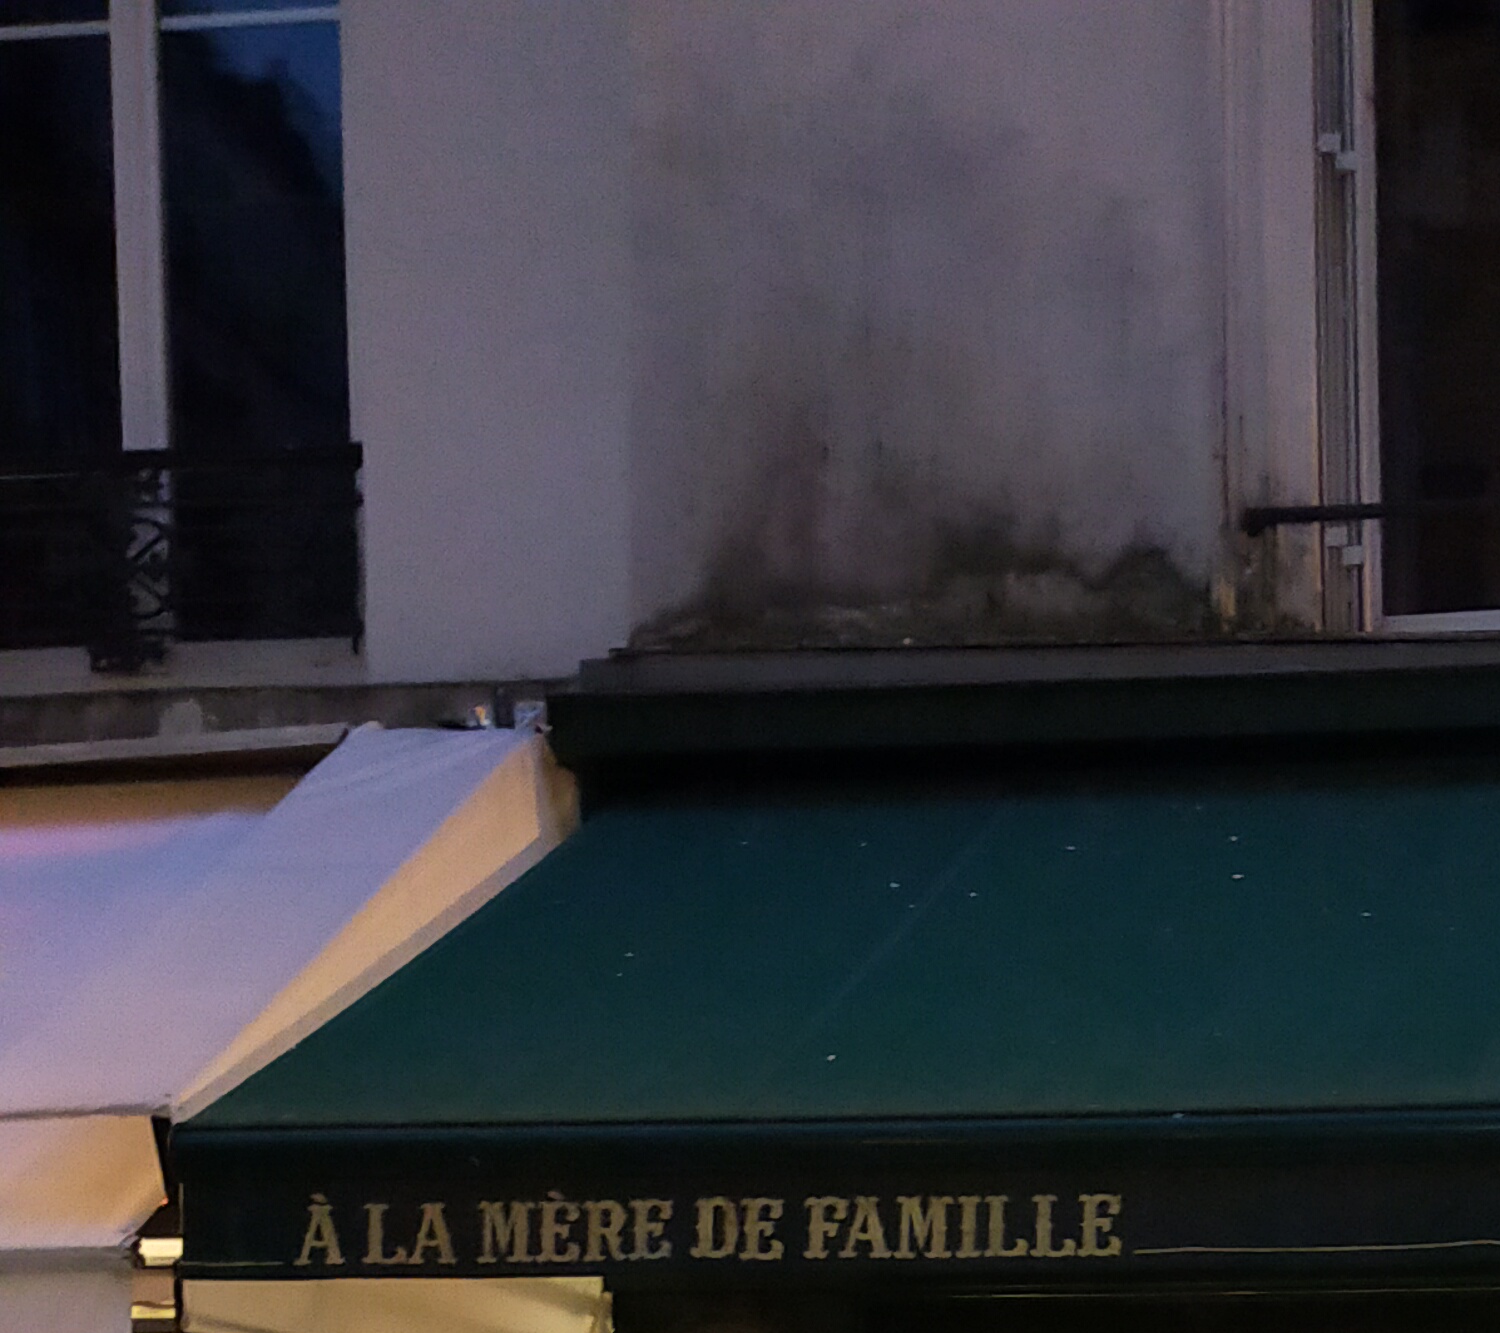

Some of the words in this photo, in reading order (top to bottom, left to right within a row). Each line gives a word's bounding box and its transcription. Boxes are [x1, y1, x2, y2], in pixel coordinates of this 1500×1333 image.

[295, 1193, 345, 1267] À
[363, 1201, 456, 1266] LA
[476, 1190, 673, 1264] MÈRE
[690, 1195, 785, 1262] DE
[804, 1192, 1124, 1261] FAMILLE
